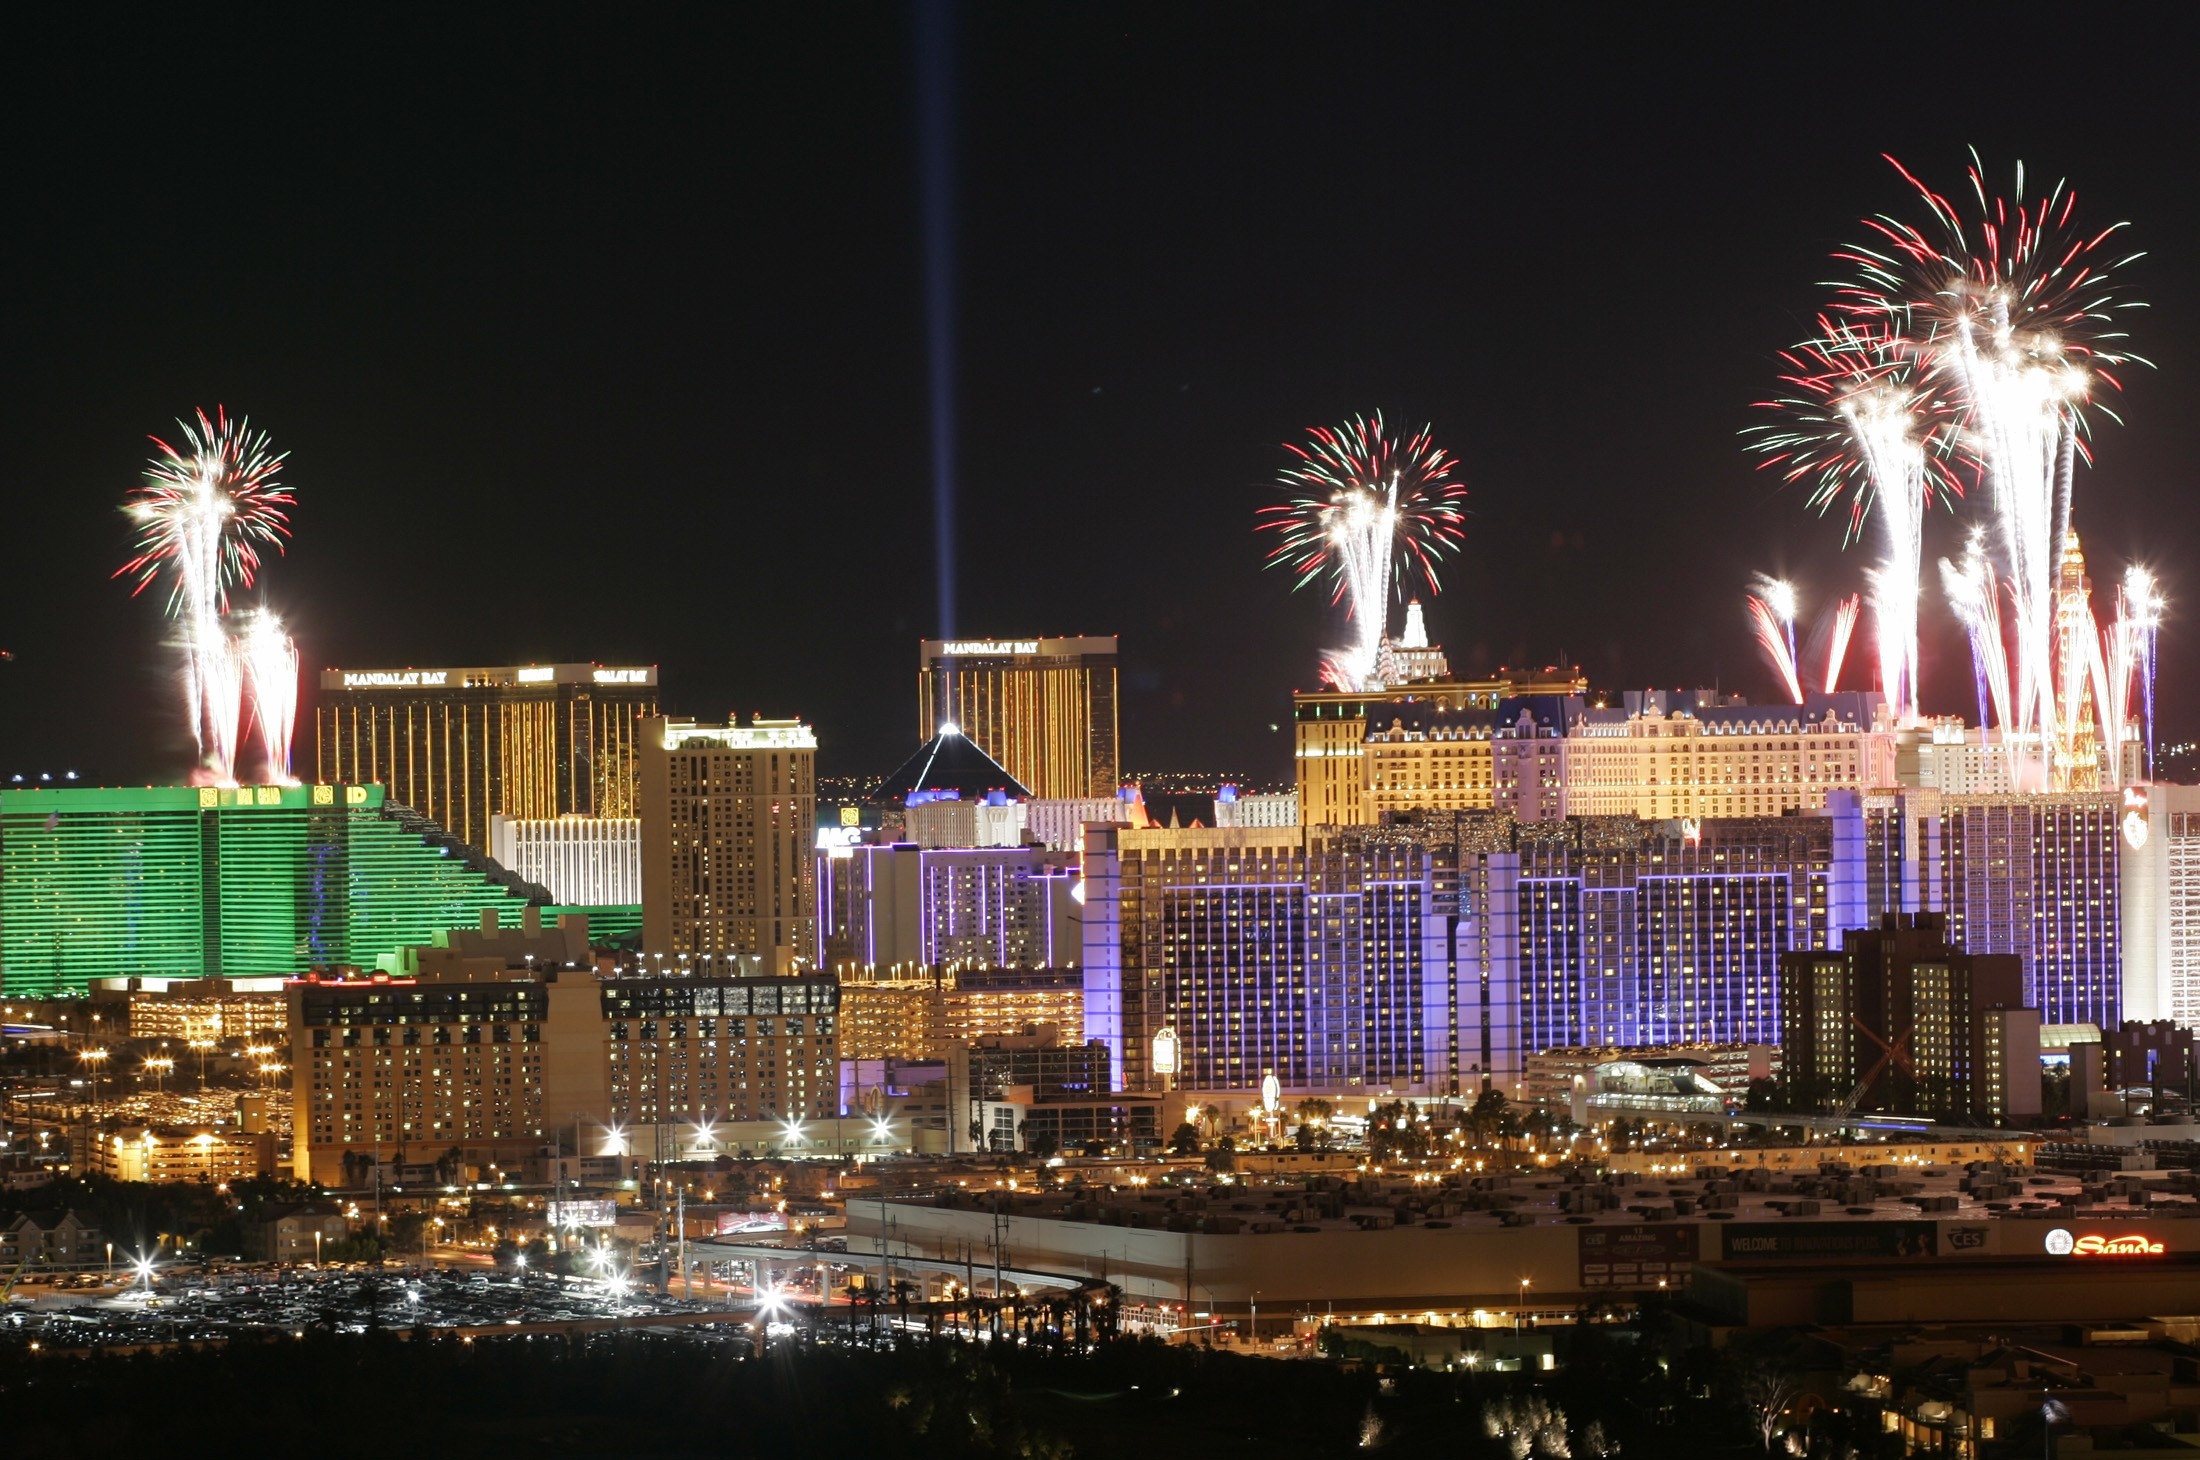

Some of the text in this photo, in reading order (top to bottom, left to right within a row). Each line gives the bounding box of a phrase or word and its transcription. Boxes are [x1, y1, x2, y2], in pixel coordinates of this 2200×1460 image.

[944, 642, 1038, 654] MANDALAY BAY
[344, 672, 447, 685] MANDALAY BAY
[1731, 1237, 1777, 1251] WELCOME
[1952, 1233, 1980, 1246] CES
[2073, 1235, 2164, 1255] Sands
